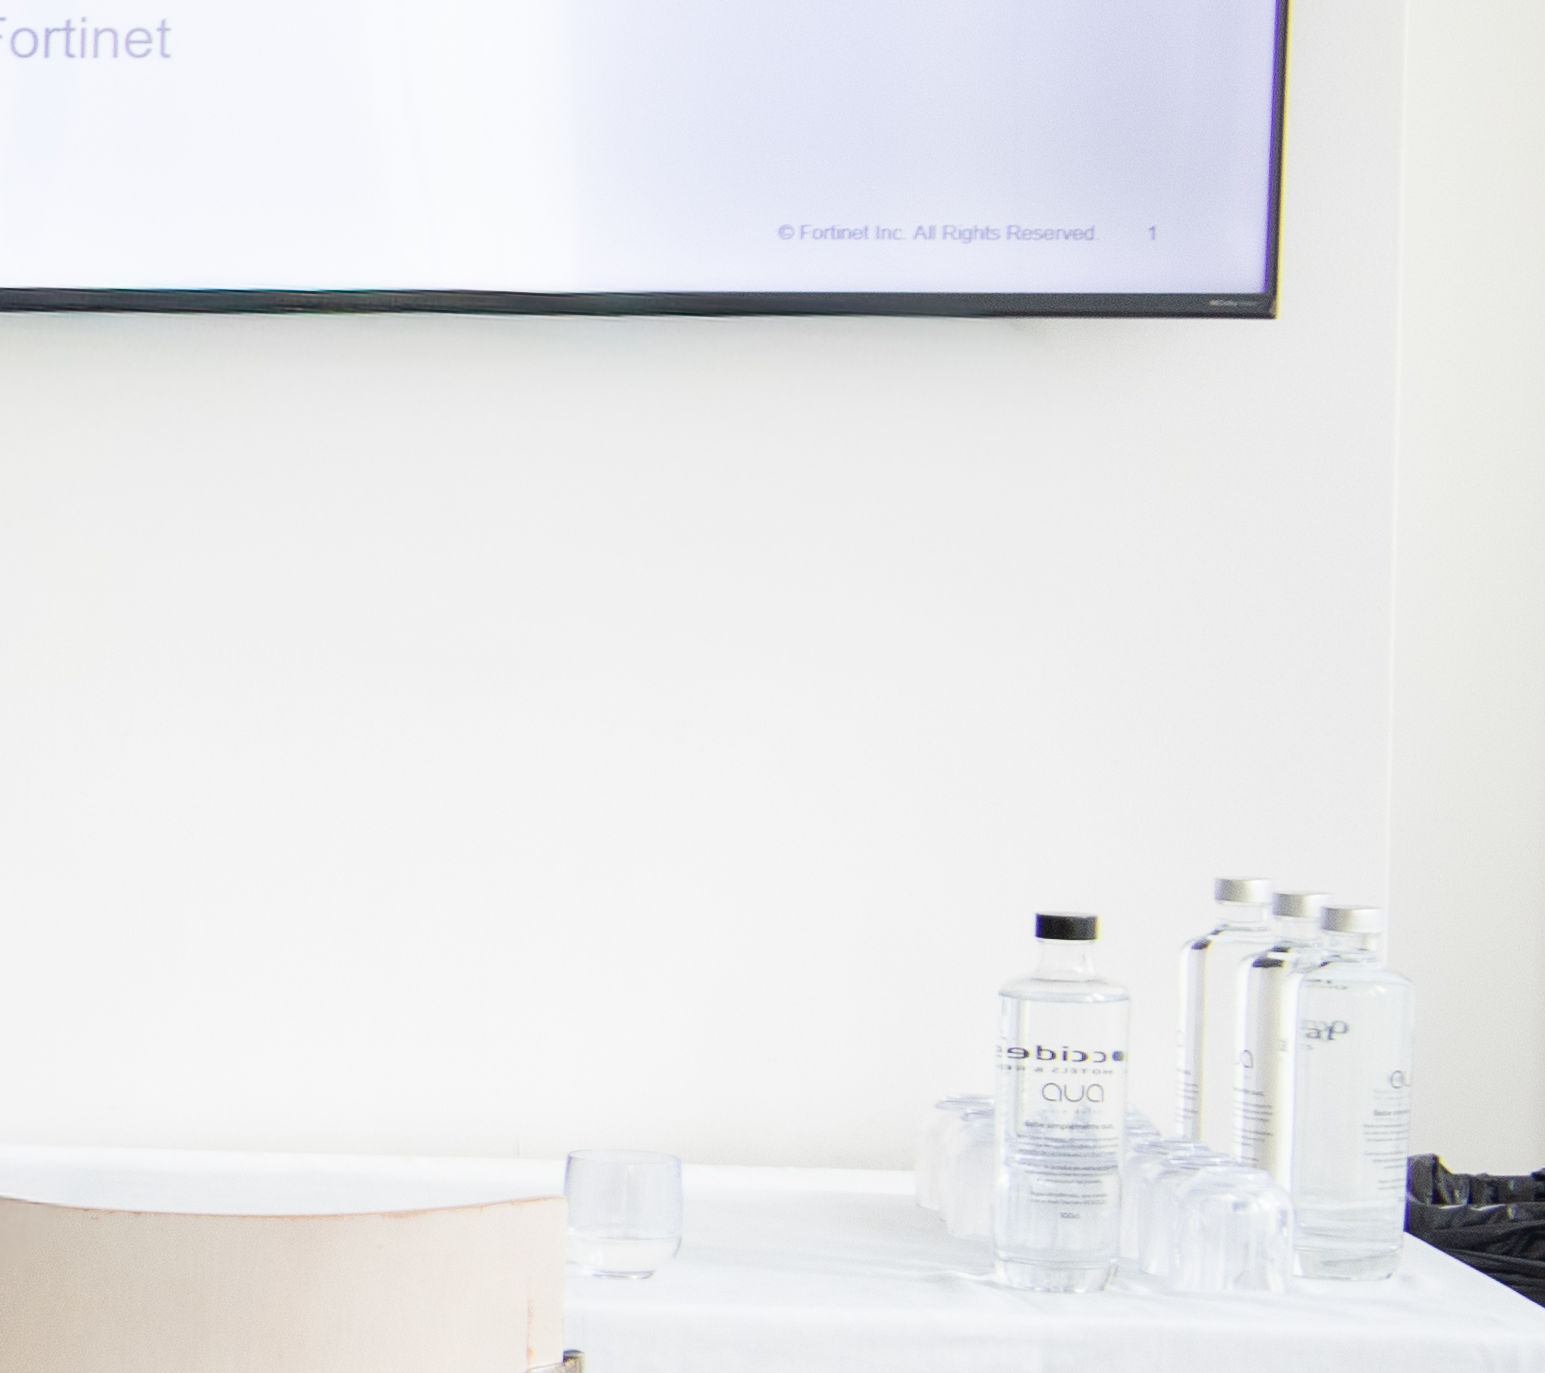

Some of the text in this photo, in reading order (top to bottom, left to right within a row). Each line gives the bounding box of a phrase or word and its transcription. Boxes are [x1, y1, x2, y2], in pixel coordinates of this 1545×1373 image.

[799, 224, 870, 242] Fortinet
[875, 225, 906, 242] Inc.
[913, 224, 938, 242] All
[942, 224, 1002, 244] Rights
[1006, 224, 1099, 242] Reserved.
[1147, 225, 1158, 242] 1
